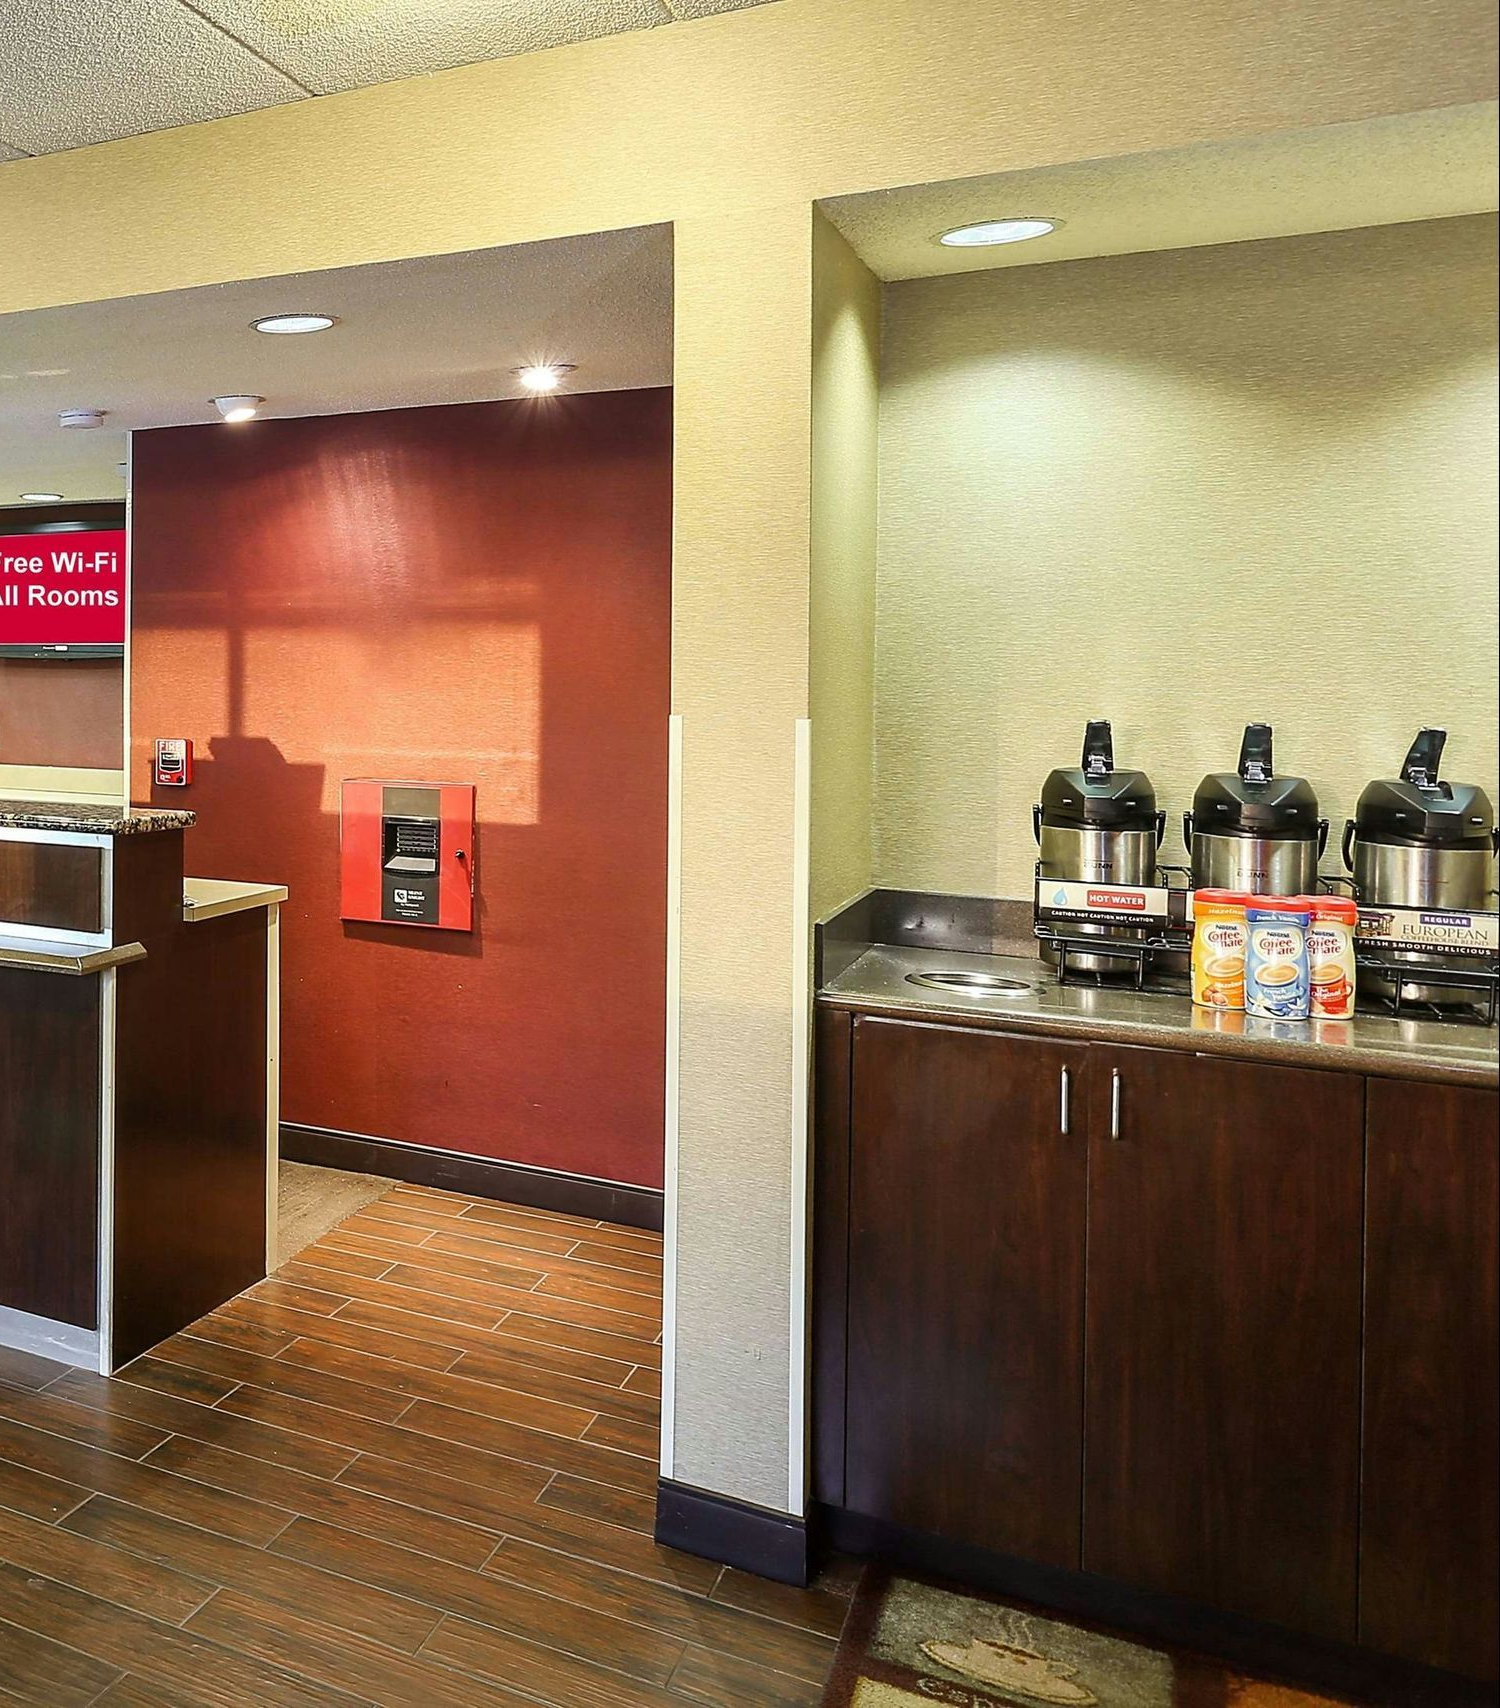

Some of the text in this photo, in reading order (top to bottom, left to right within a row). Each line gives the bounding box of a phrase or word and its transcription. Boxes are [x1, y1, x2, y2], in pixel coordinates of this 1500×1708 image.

[51, 552, 117, 573] Wi-Fi
[28, 585, 119, 606] Rooms
[1089, 894, 1144, 906] HOT WATER
[1316, 913, 1343, 922] Original
[1424, 916, 1468, 926] REGULAR
[1402, 924, 1488, 940] EUROPEAN
[1392, 942, 1434, 951] SMOOTH
[1437, 945, 1491, 956] DELICIOUS
